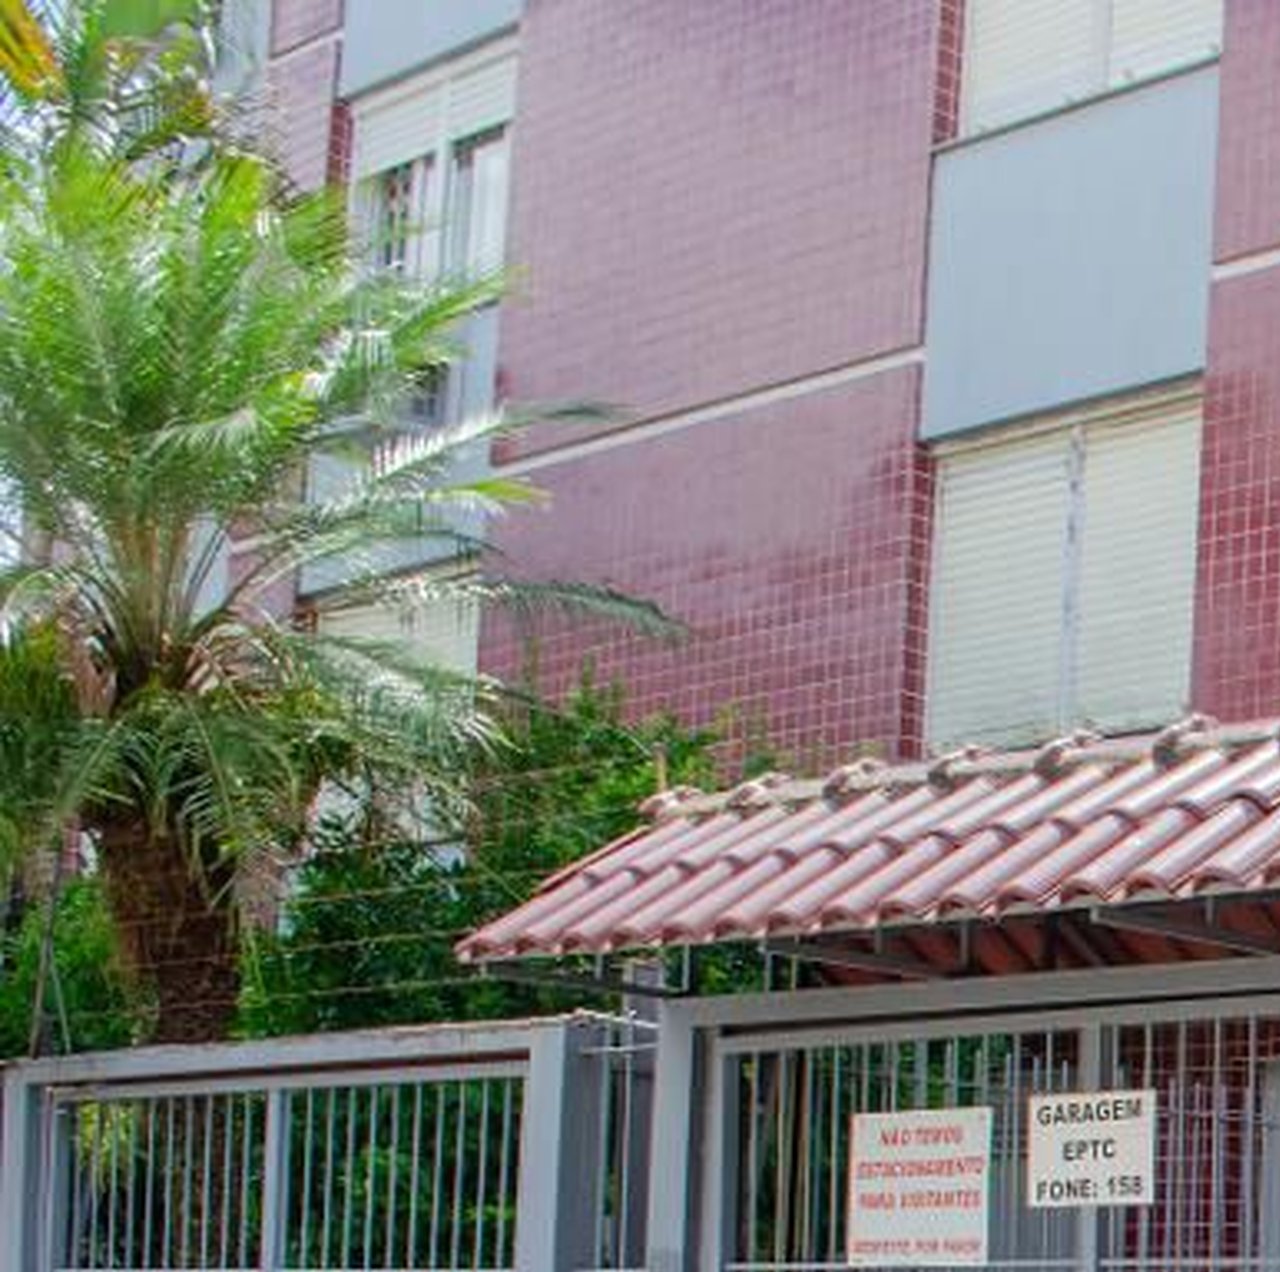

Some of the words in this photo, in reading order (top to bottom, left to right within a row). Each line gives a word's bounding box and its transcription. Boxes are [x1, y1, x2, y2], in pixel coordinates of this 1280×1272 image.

[1036, 1098, 1142, 1125] GARAGEM
[1062, 1138, 1116, 1161] EPTC
[1035, 1178, 1098, 1201] FONE:
[1106, 1175, 1143, 1196] 158
